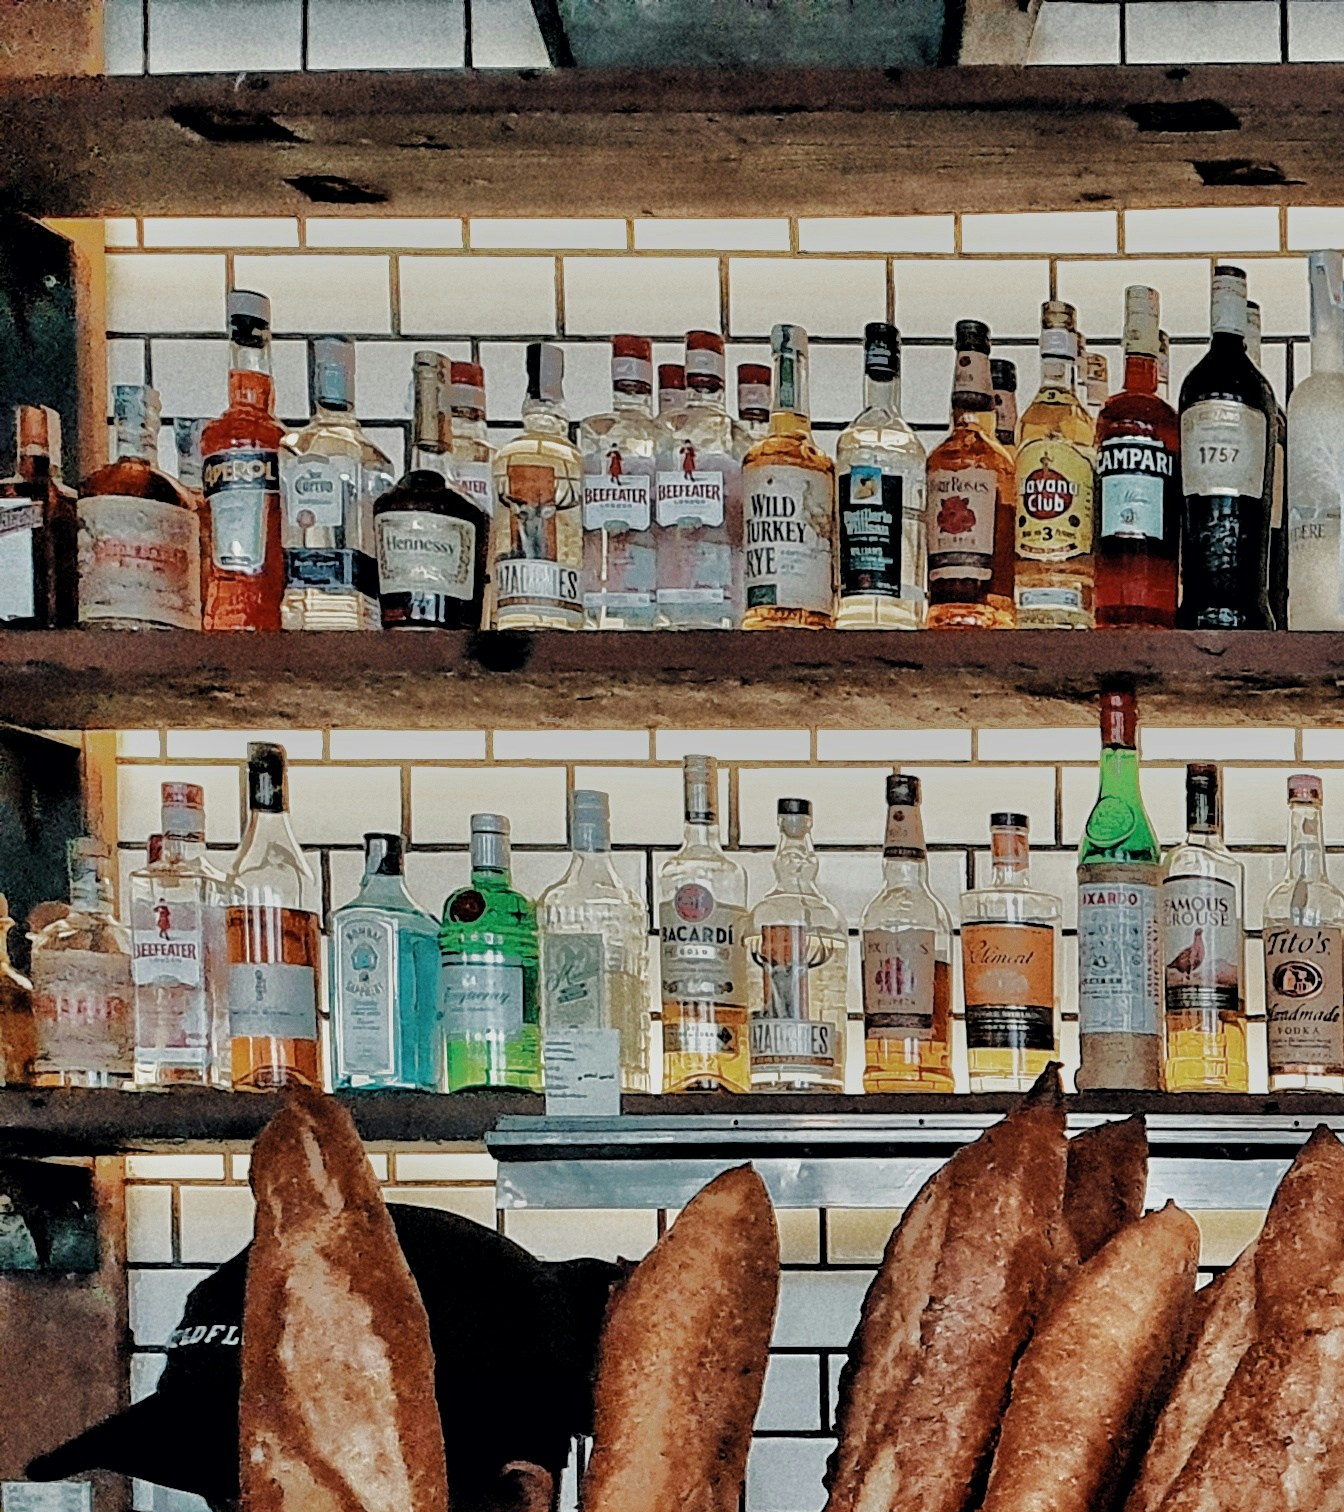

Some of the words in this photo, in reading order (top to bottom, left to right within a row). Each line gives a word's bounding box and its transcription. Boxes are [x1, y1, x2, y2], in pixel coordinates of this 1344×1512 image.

[1097, 446, 1175, 477] CAMPARI
[1199, 446, 1240, 465] 1757
[204, 460, 277, 488] APEROL
[585, 488, 648, 505] BEEFEATER
[658, 484, 721, 502] BEEFEATER
[751, 493, 797, 519] WILD
[1028, 494, 1066, 513] Club
[746, 519, 808, 545] TURKEY
[1042, 526, 1053, 541] 3
[386, 536, 457, 556] Hennessy
[746, 547, 778, 578] RYE
[134, 942, 198, 960] BEEFEATER
[1268, 931, 1331, 956] Tito's
[1276, 1026, 1321, 1036] VODKA
